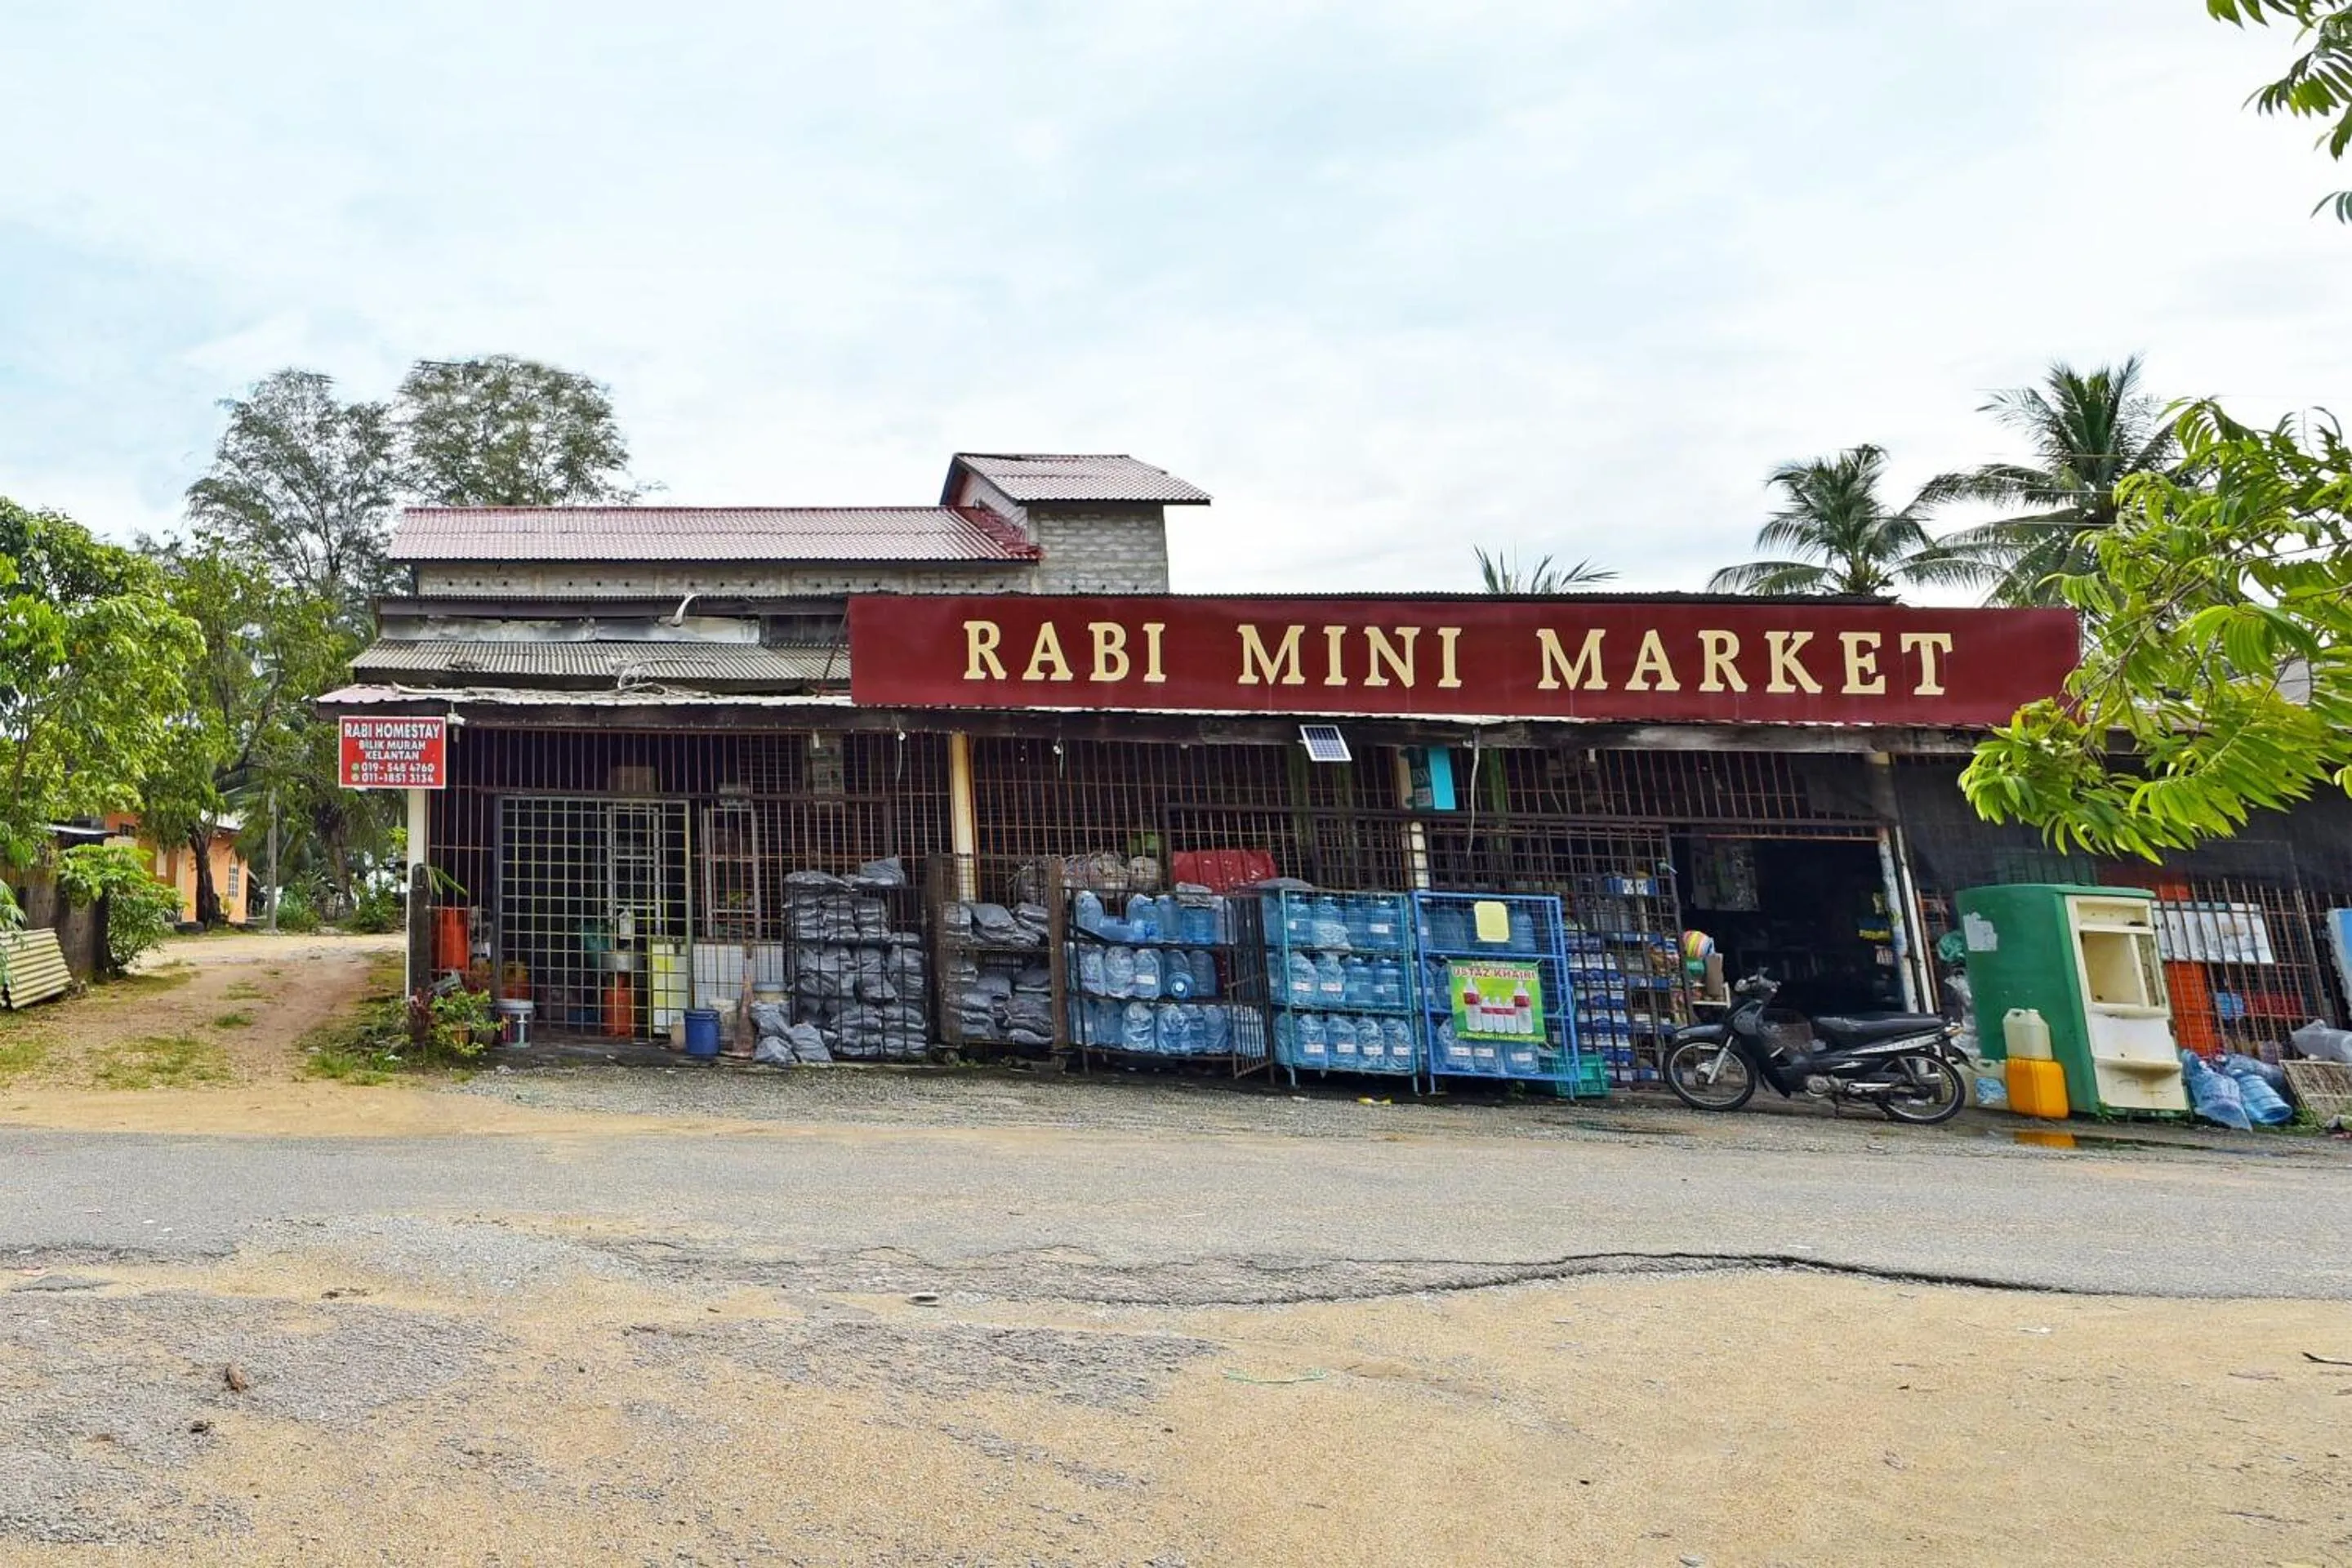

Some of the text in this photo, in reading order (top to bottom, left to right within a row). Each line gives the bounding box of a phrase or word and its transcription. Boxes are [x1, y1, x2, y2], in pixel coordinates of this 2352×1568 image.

[963, 621, 1953, 696] RABI MINI MARKET
[344, 723, 440, 739] RABI HOMESTAY
[359, 739, 425, 751] BILIK MURAH
[365, 751, 420, 760] KELANTAN
[409, 763, 435, 773] 4760
[1454, 966, 1490, 978] USTAZ
